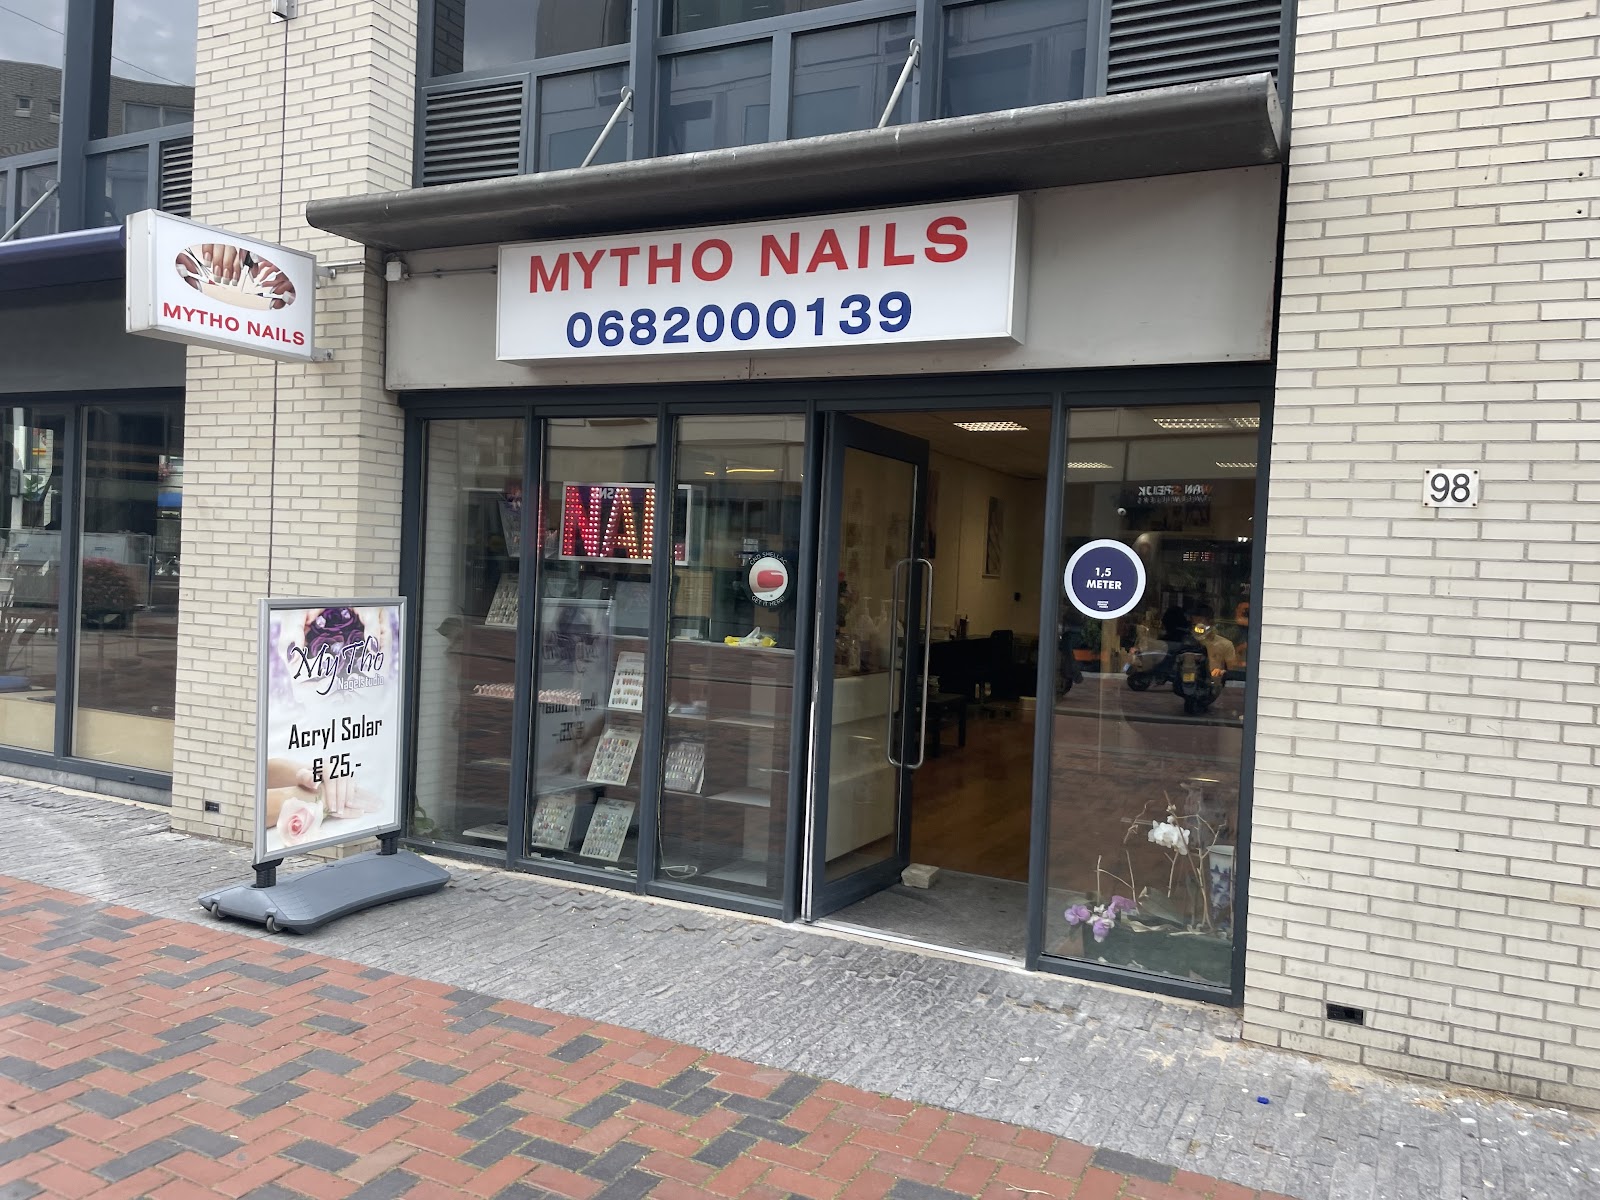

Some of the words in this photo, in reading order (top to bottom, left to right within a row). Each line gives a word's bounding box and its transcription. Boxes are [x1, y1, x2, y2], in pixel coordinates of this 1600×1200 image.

[529, 239, 733, 294] MYTHO
[760, 215, 968, 277] NAILS
[163, 302, 240, 332] MYTHO
[247, 321, 305, 346] NAILS
[566, 290, 912, 348] 0682000139
[1430, 473, 1471, 503] 98
[1086, 579, 1122, 590] METER
[1095, 567, 1112, 578] 1,5
[337, 674, 384, 692] Nagelstudio
[288, 718, 336, 750] Acryl
[341, 714, 383, 742] Solar
[329, 752, 362, 781] 25,-
